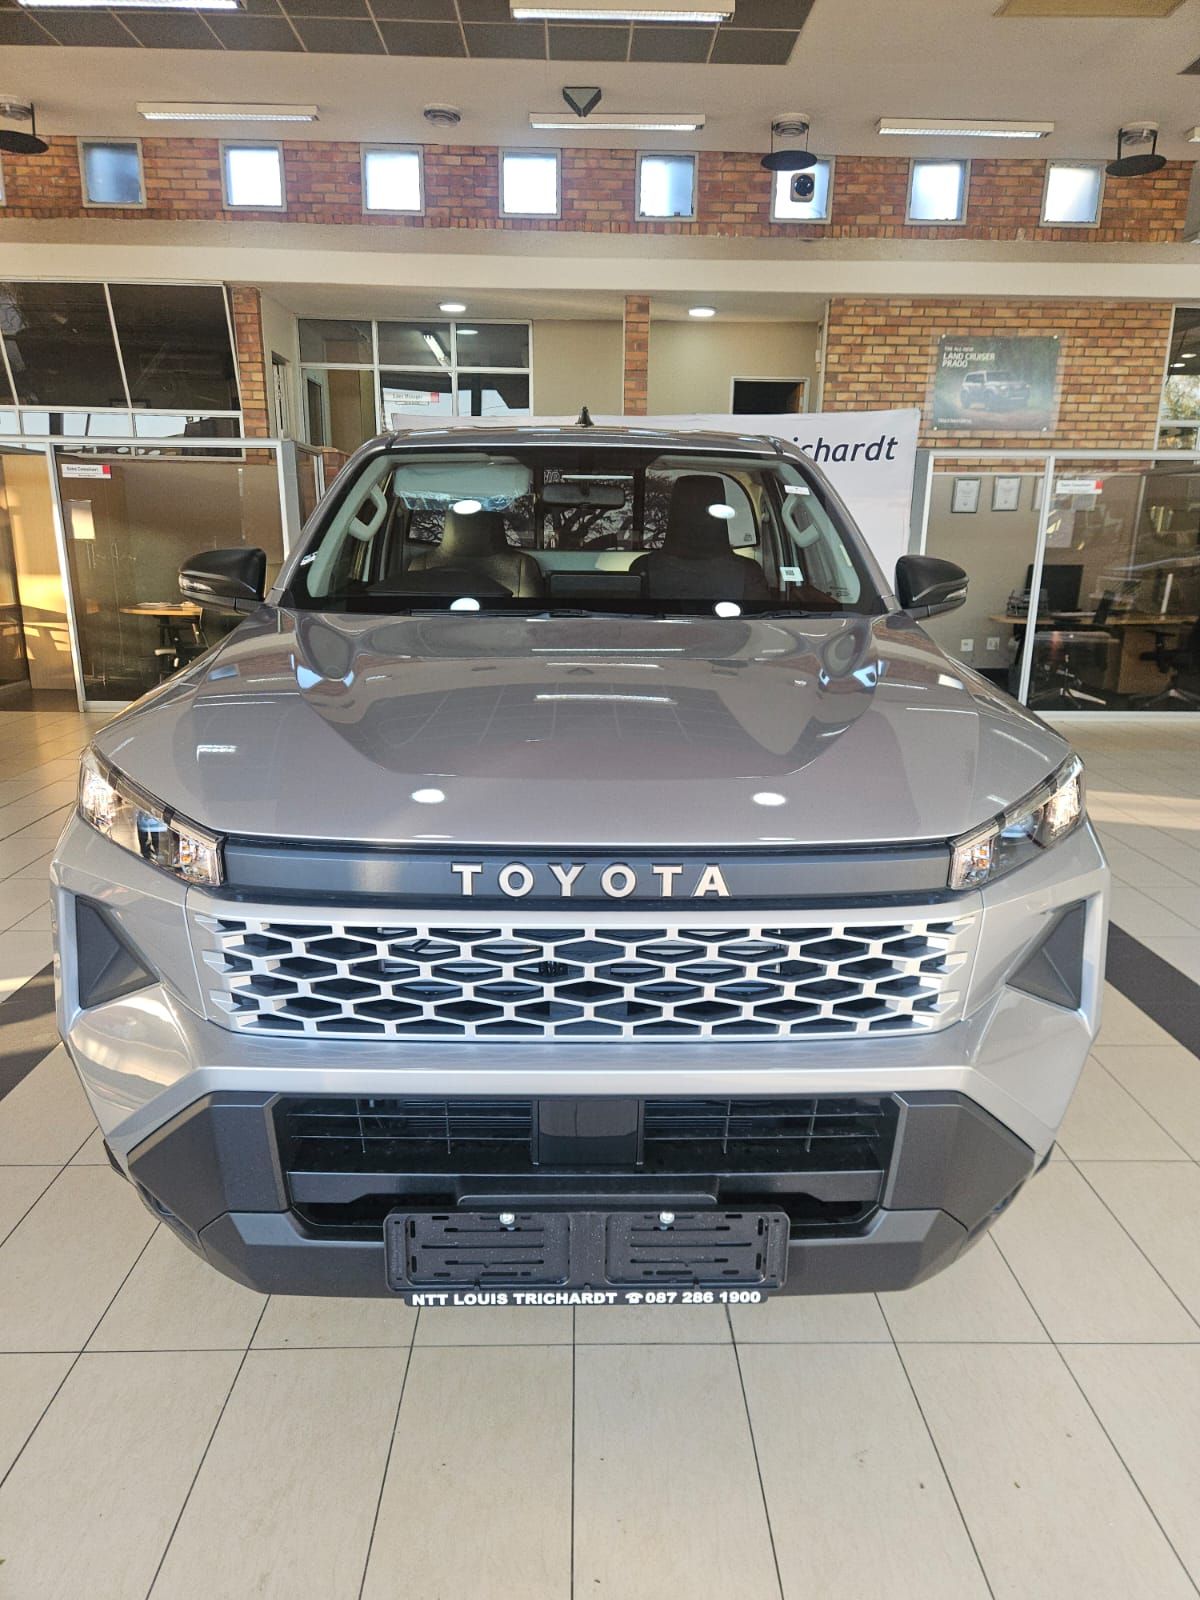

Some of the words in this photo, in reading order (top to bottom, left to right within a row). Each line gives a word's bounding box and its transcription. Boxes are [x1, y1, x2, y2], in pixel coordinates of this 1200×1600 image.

[943, 352, 965, 361] LAND
[965, 352, 996, 361] CRUISER
[942, 360, 968, 368] PRADO
[451, 863, 731, 898] TOYOTA
[412, 1294, 448, 1305] NTT
[453, 1293, 508, 1305] LOUIS
[513, 1292, 617, 1305] TRICHARDT
[645, 1291, 677, 1303] 087
[681, 1291, 714, 1303] 286
[719, 1290, 761, 1303] 1900
